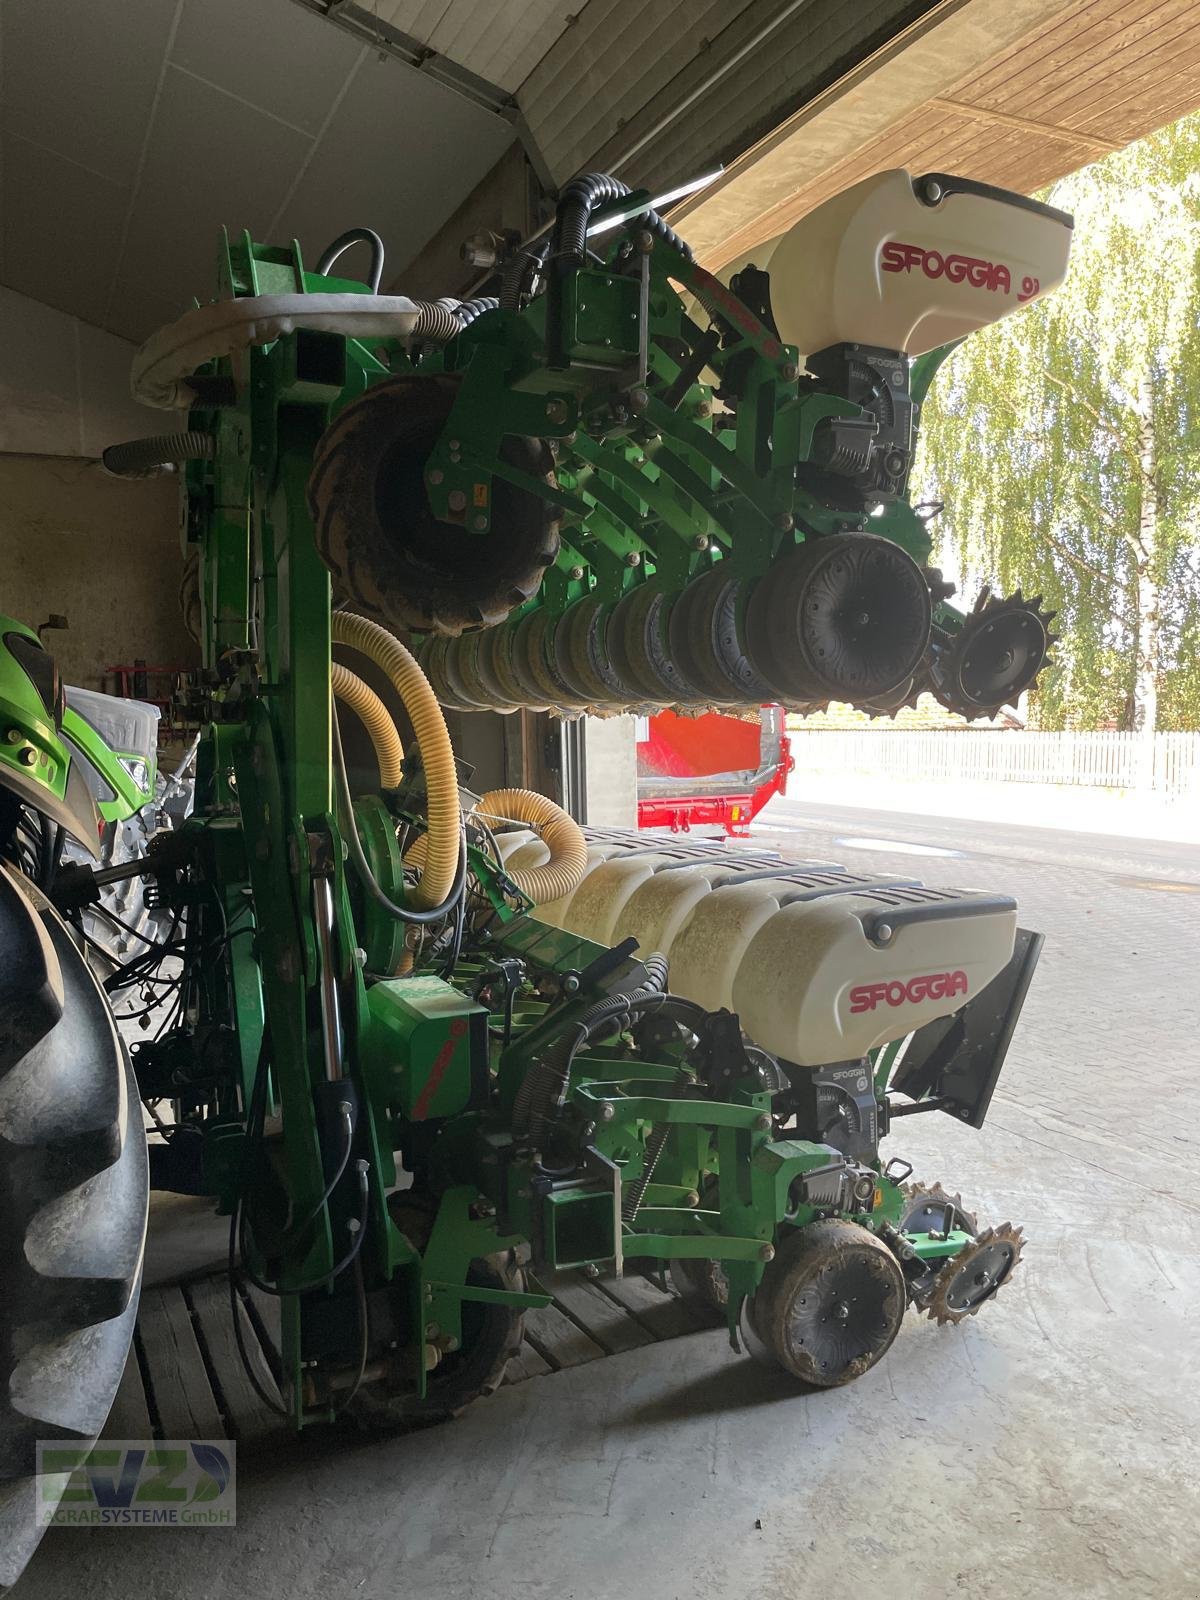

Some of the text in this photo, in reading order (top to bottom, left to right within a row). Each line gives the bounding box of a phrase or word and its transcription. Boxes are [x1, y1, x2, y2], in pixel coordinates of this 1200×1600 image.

[881, 241, 1011, 295] SFOGGIA
[850, 970, 968, 1014] SFOGGIA
[832, 1068, 866, 1081] SFOGGIA
